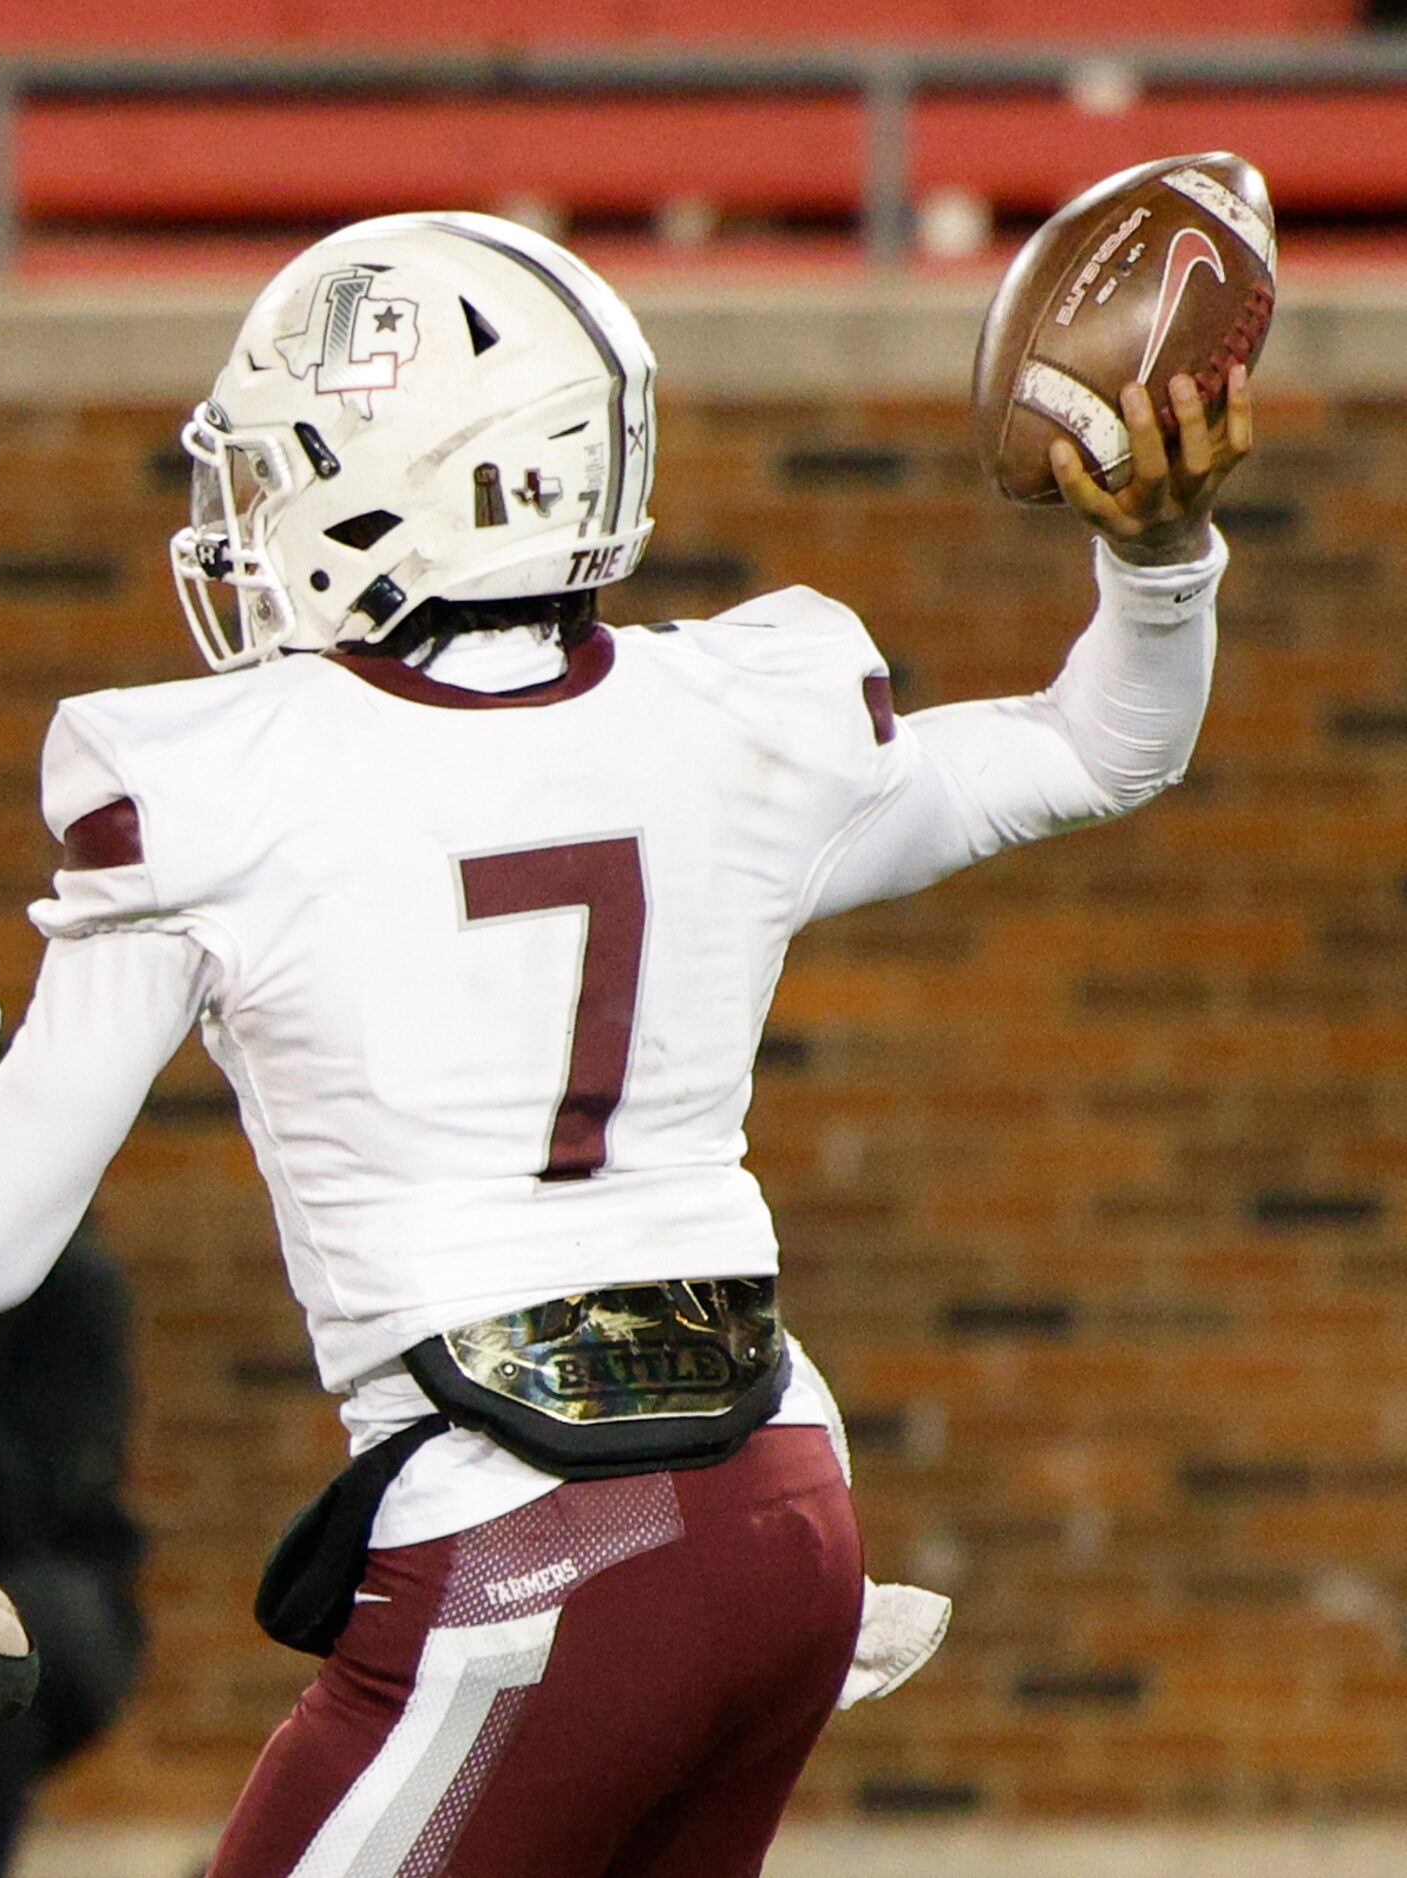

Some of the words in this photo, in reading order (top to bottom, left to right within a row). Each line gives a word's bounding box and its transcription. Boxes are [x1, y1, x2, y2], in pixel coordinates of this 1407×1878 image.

[1090, 206, 1152, 264] VAPOR
[1055, 260, 1101, 327] ELITE
[577, 489, 601, 539] 7
[566, 544, 625, 586] THE
[452, 830, 651, 1190] 7
[483, 1557, 580, 1606] FARMERS
